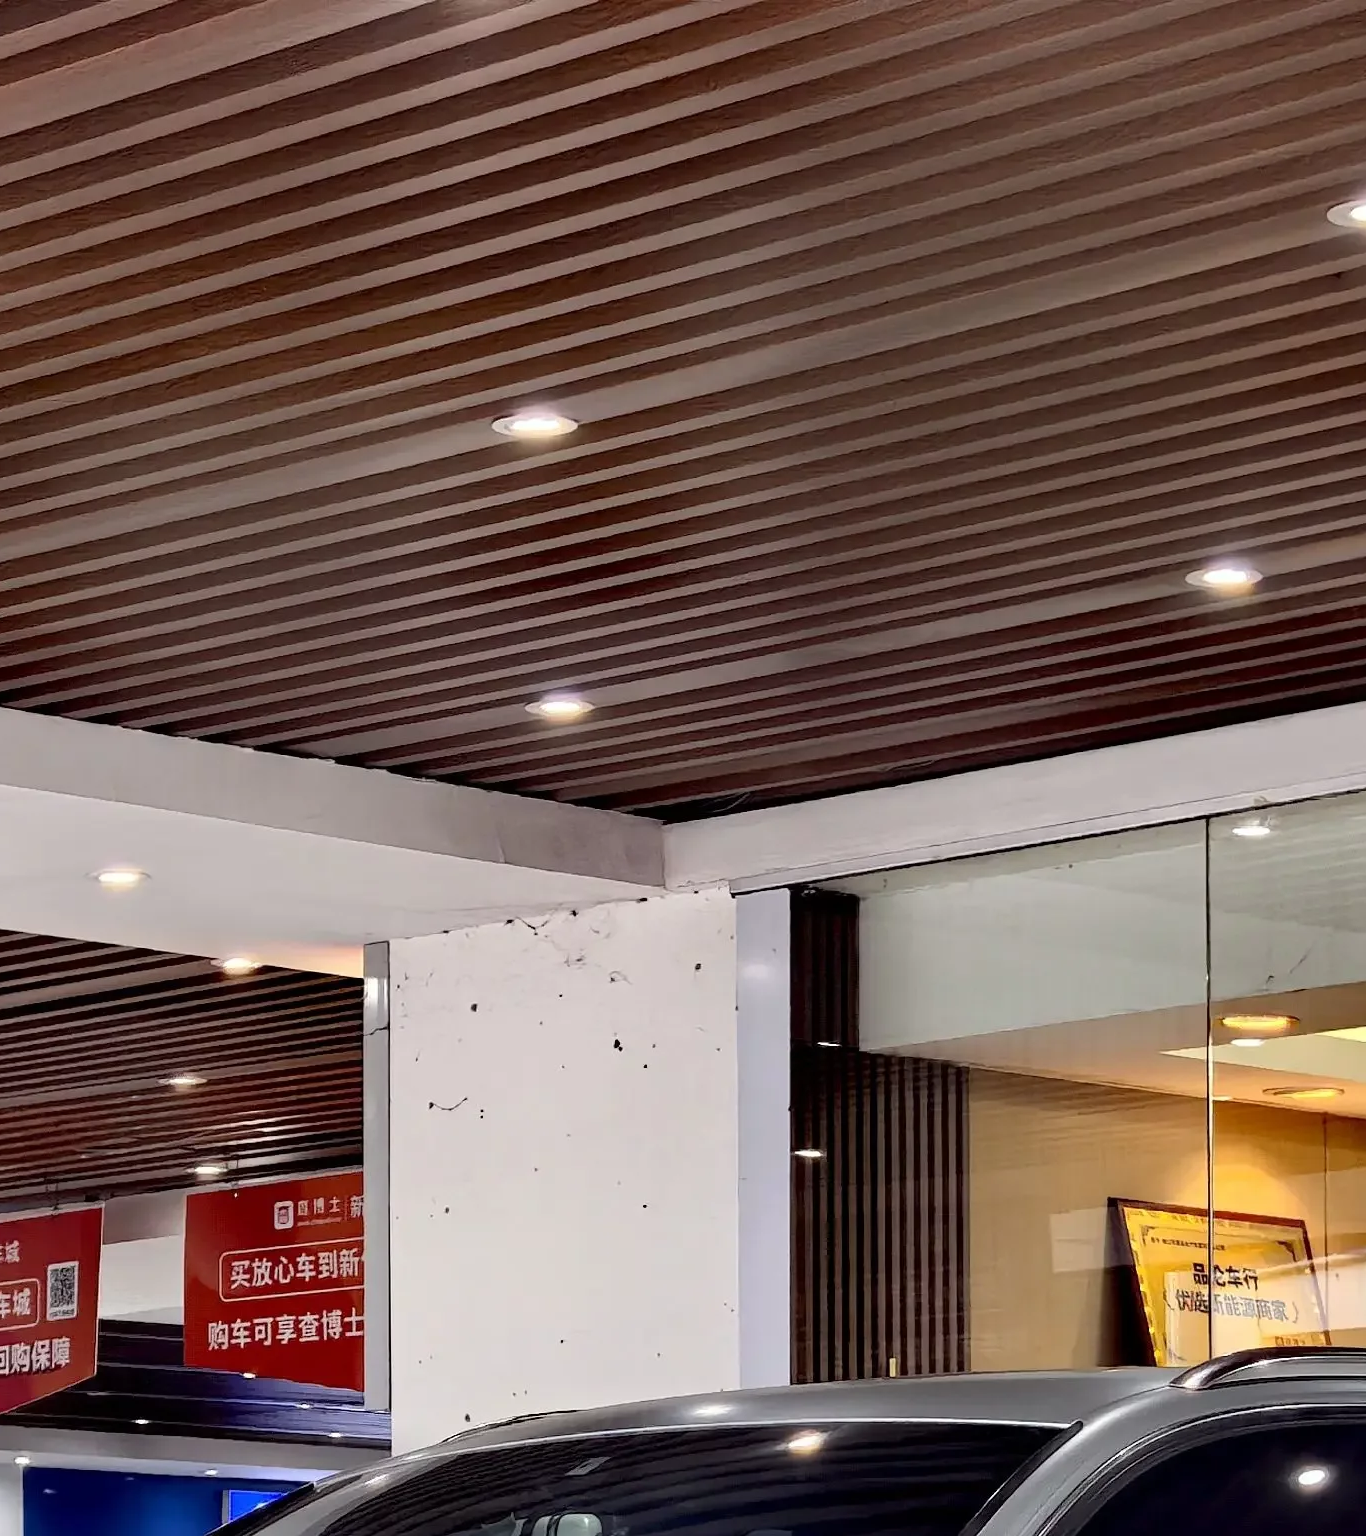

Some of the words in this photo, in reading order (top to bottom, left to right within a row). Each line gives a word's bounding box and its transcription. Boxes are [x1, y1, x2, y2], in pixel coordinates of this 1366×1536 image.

[230, 1248, 364, 1290] 买放心车到新
[208, 1307, 364, 1351] 购车可享查博士
